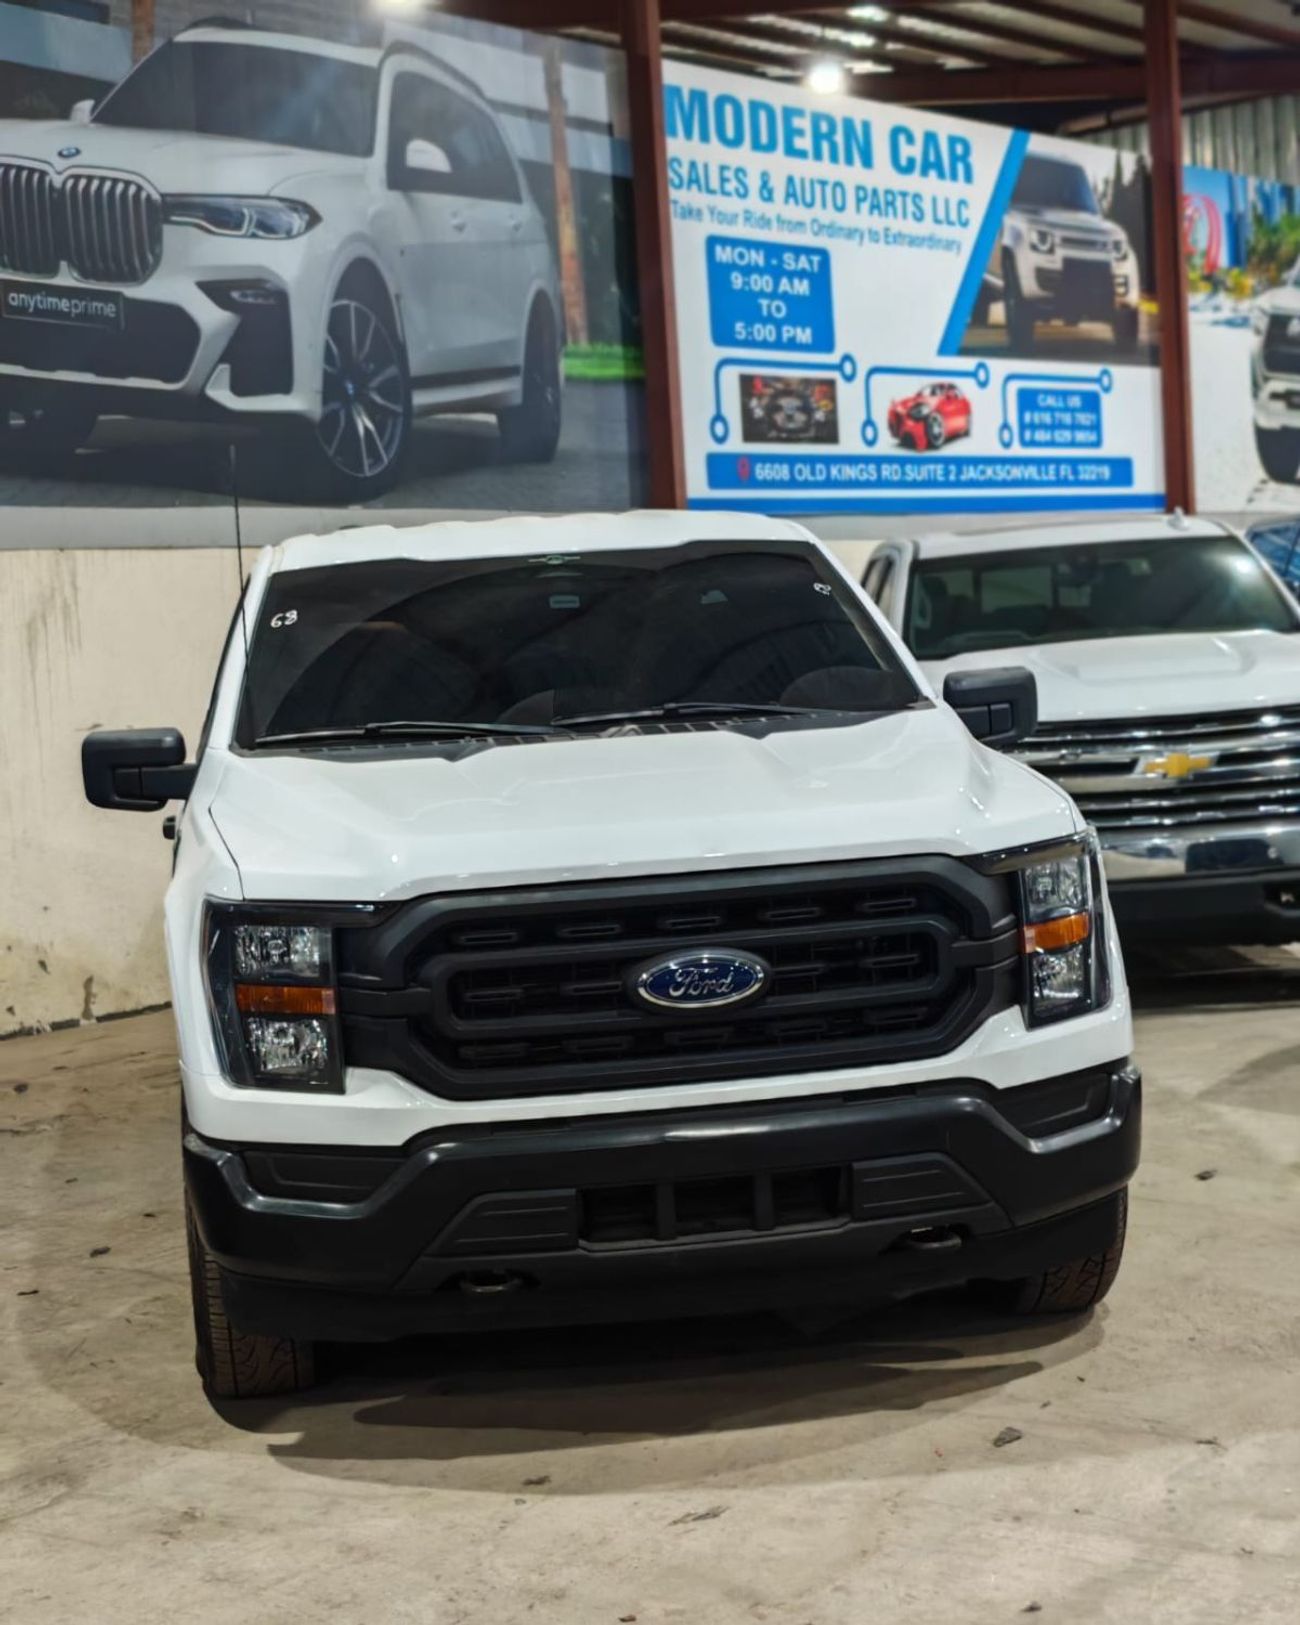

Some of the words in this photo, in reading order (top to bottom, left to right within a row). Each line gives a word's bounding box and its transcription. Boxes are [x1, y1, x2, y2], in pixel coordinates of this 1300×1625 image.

[664, 84, 874, 169] MODERN
[888, 124, 973, 184] CAR
[669, 156, 749, 199] SALES
[758, 171, 774, 203] &
[784, 174, 847, 213] AUTO
[855, 185, 925, 222] PARTS
[932, 196, 970, 228] LLC
[671, 199, 703, 221] Take
[707, 204, 738, 226] Your
[743, 209, 772, 231] Ride
[776, 213, 807, 233] from
[810, 218, 864, 246] Ordinary
[868, 227, 879, 244] to
[883, 227, 961, 256] Extraordinary
[715, 244, 765, 267] MON
[782, 252, 821, 273] SAT
[730, 271, 773, 292] 9:00
[778, 276, 810, 296] AM
[8, 291, 117, 317] anytimeprime
[758, 299, 787, 318] TO
[735, 322, 776, 342] 5:00
[781, 325, 812, 344] PM
[1037, 394, 1064, 408] CALL
[755, 463, 790, 481] 6608
[794, 463, 826, 481] OLD
[830, 463, 877, 481] KINGS
[948, 464, 957, 481] 2
[960, 464, 1056, 481] JACKSONVILLE
[1060, 465, 1074, 480] FL
[669, 968, 735, 997] Ford
